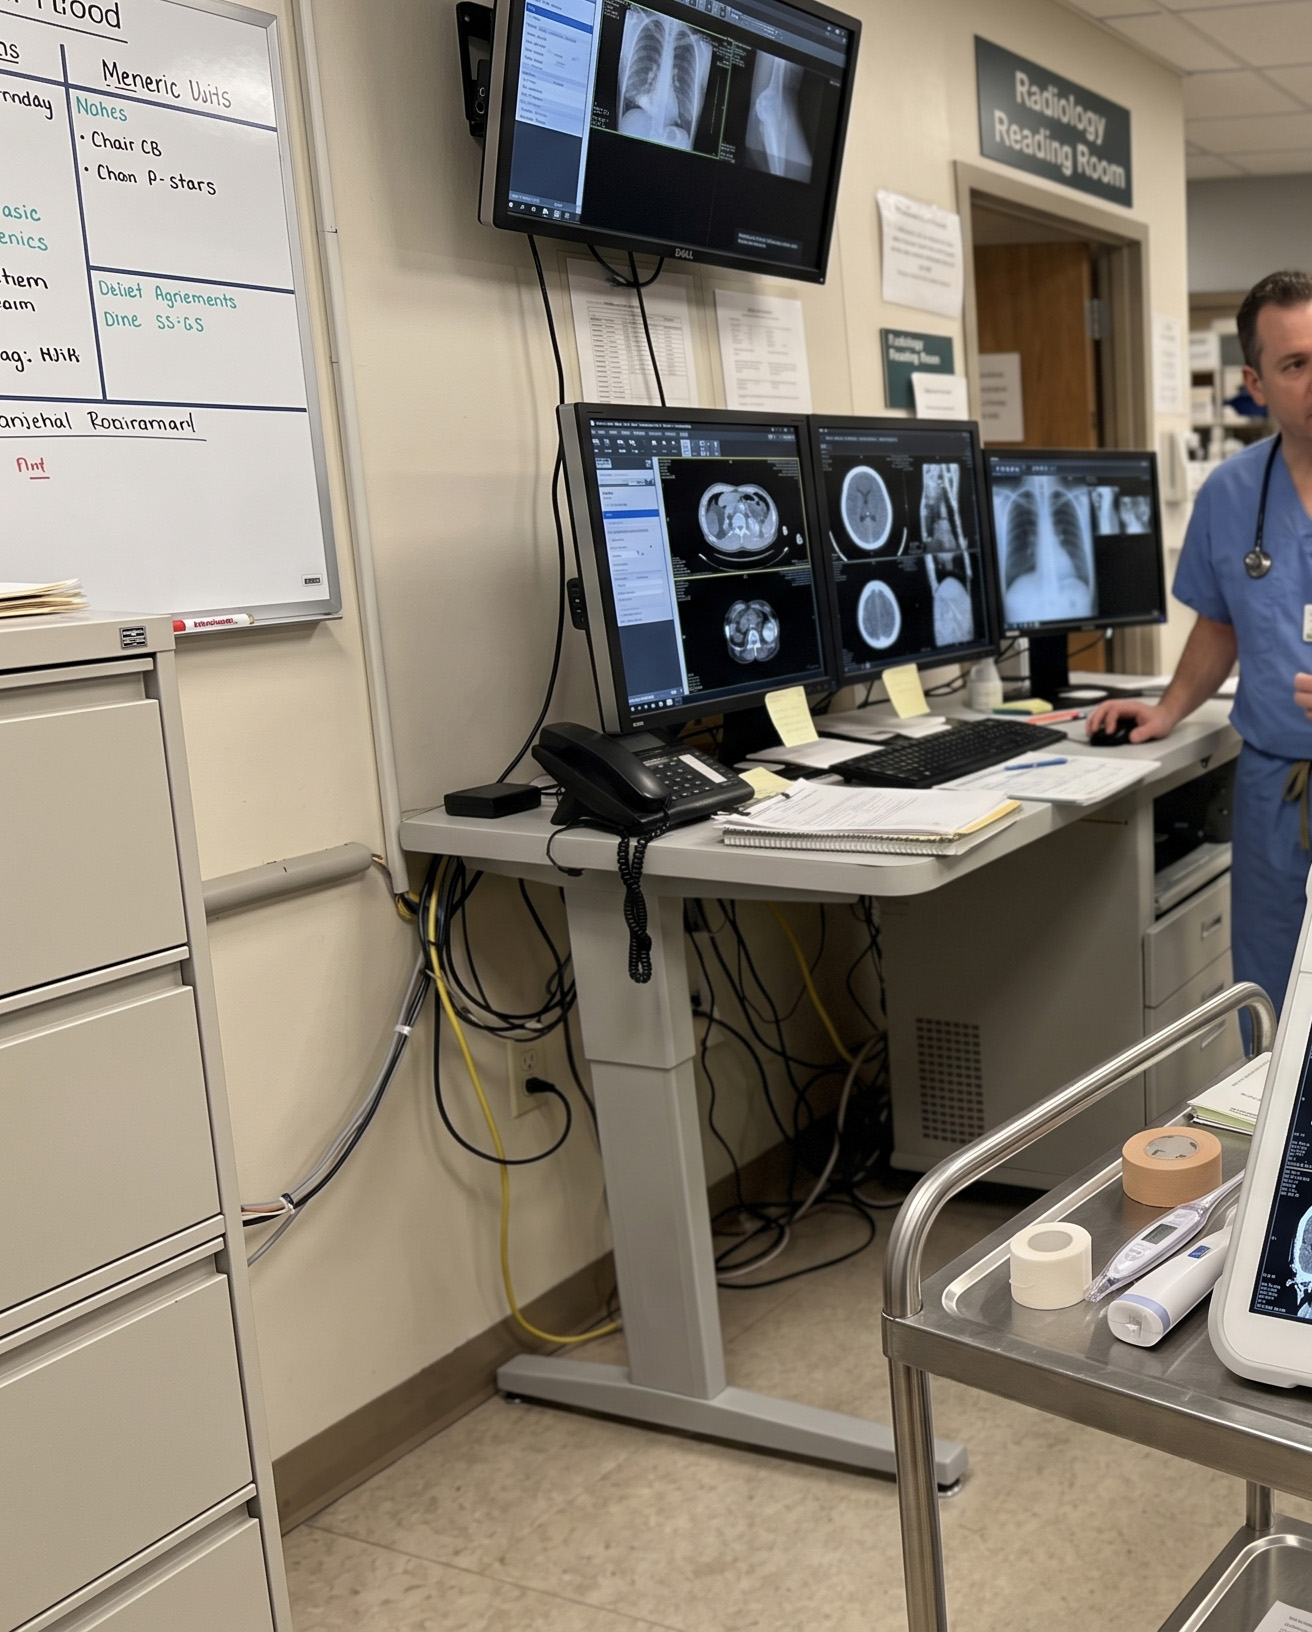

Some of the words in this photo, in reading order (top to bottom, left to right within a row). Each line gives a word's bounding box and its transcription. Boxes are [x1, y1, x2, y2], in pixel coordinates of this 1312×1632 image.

[91, 130, 135, 152] Chair
[141, 139, 162, 157] CB
[1015, 71, 1106, 145] Radiology
[994, 109, 1073, 177] Reading
[1077, 144, 1126, 189] Room
